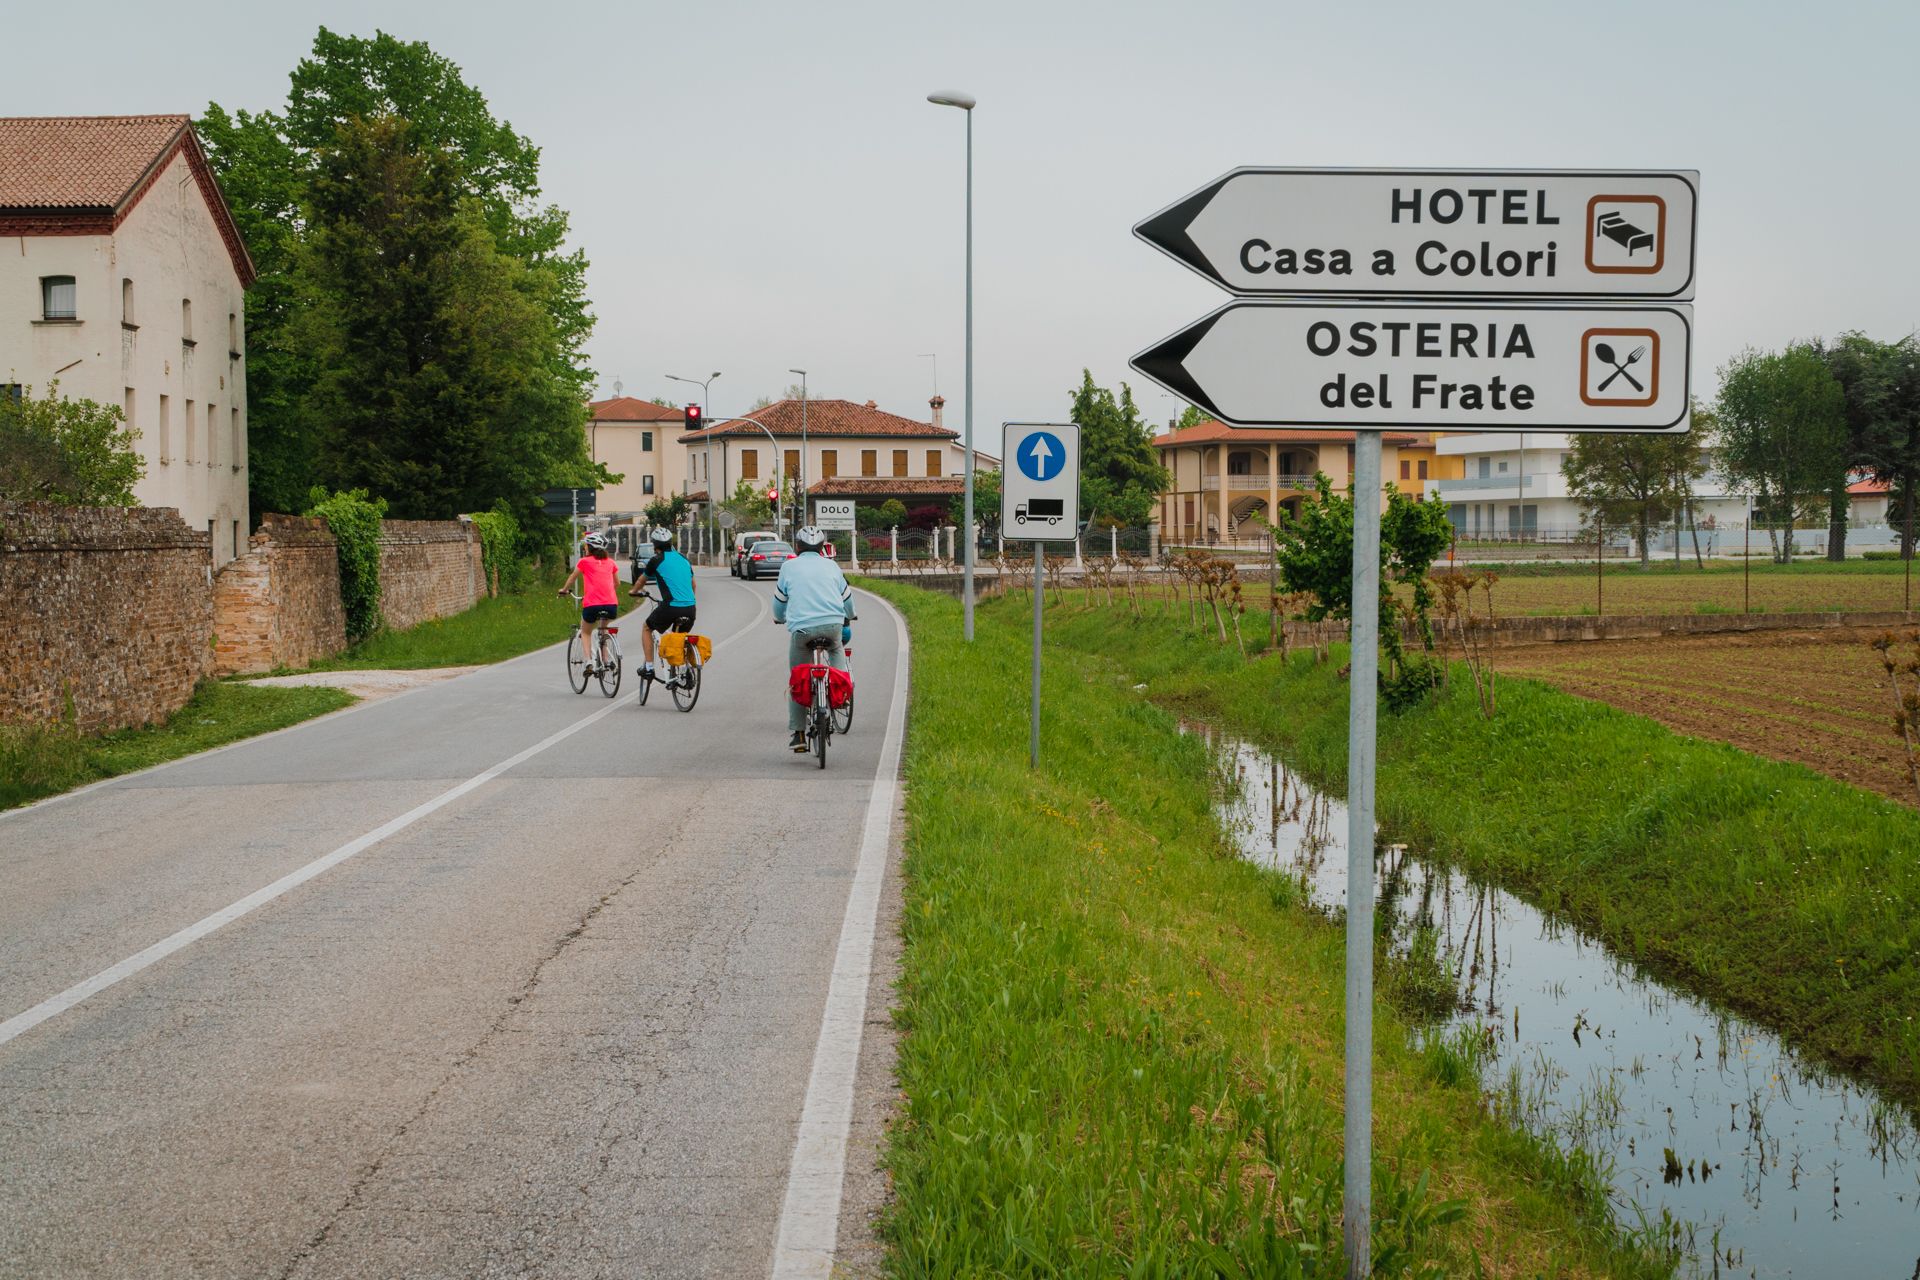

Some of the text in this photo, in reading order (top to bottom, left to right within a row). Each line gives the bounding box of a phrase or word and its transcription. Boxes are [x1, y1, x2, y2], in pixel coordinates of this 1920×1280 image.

[1391, 188, 1560, 225] HOTEL
[1239, 239, 1556, 278] Casa a Colori
[1307, 321, 1536, 358] OSTERIA
[1319, 374, 1535, 410] del Frate
[821, 505, 850, 514] DOLO
